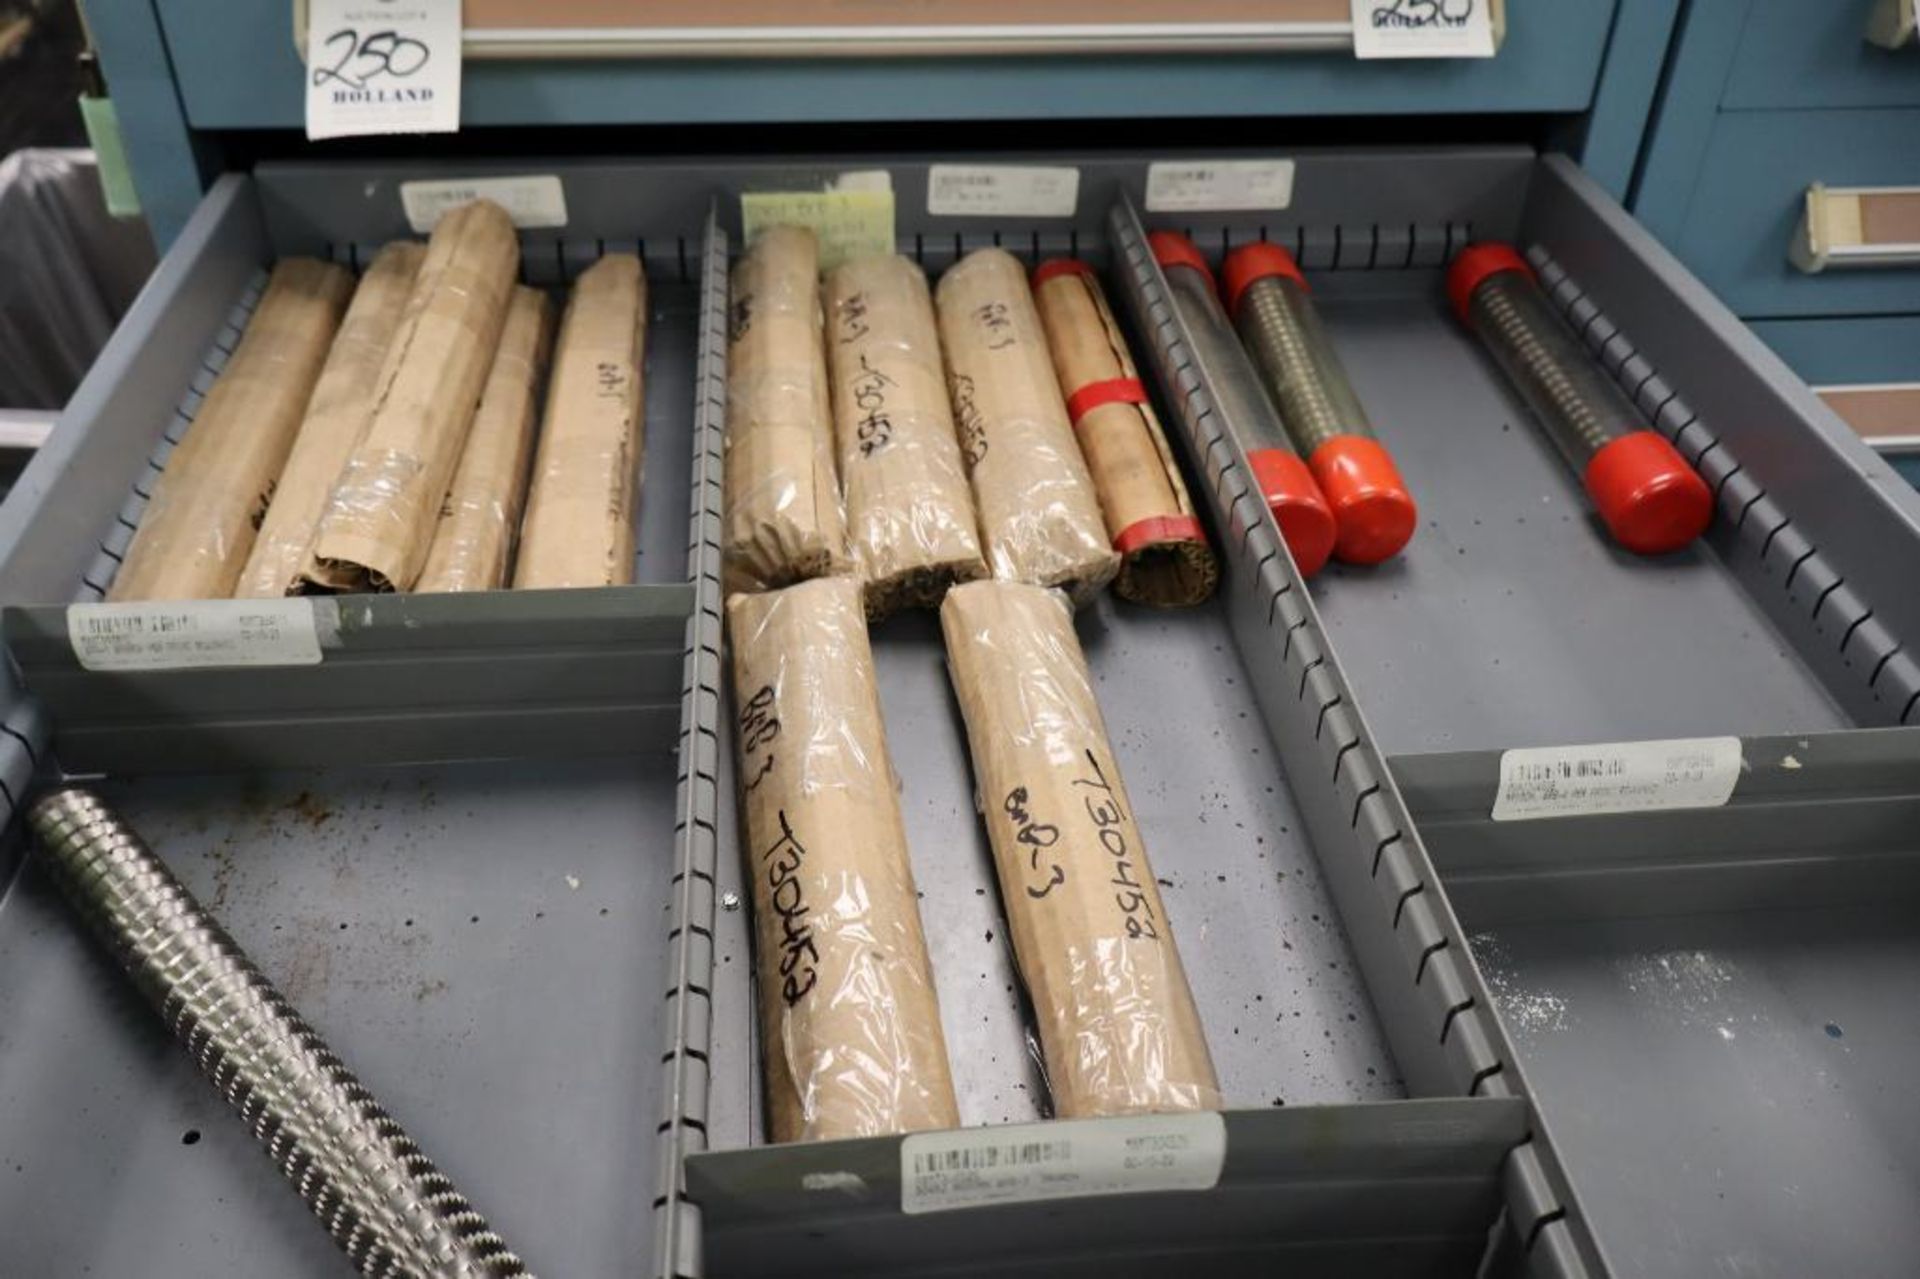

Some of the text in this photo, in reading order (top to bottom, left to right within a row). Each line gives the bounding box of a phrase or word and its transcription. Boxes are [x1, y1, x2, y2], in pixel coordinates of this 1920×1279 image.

[1372, 0, 1473, 28] 250
[313, 28, 430, 90] 250
[332, 89, 434, 105] HOLLAND
[1072, 747, 1158, 942] T30452
[762, 809, 818, 1008] T30452
